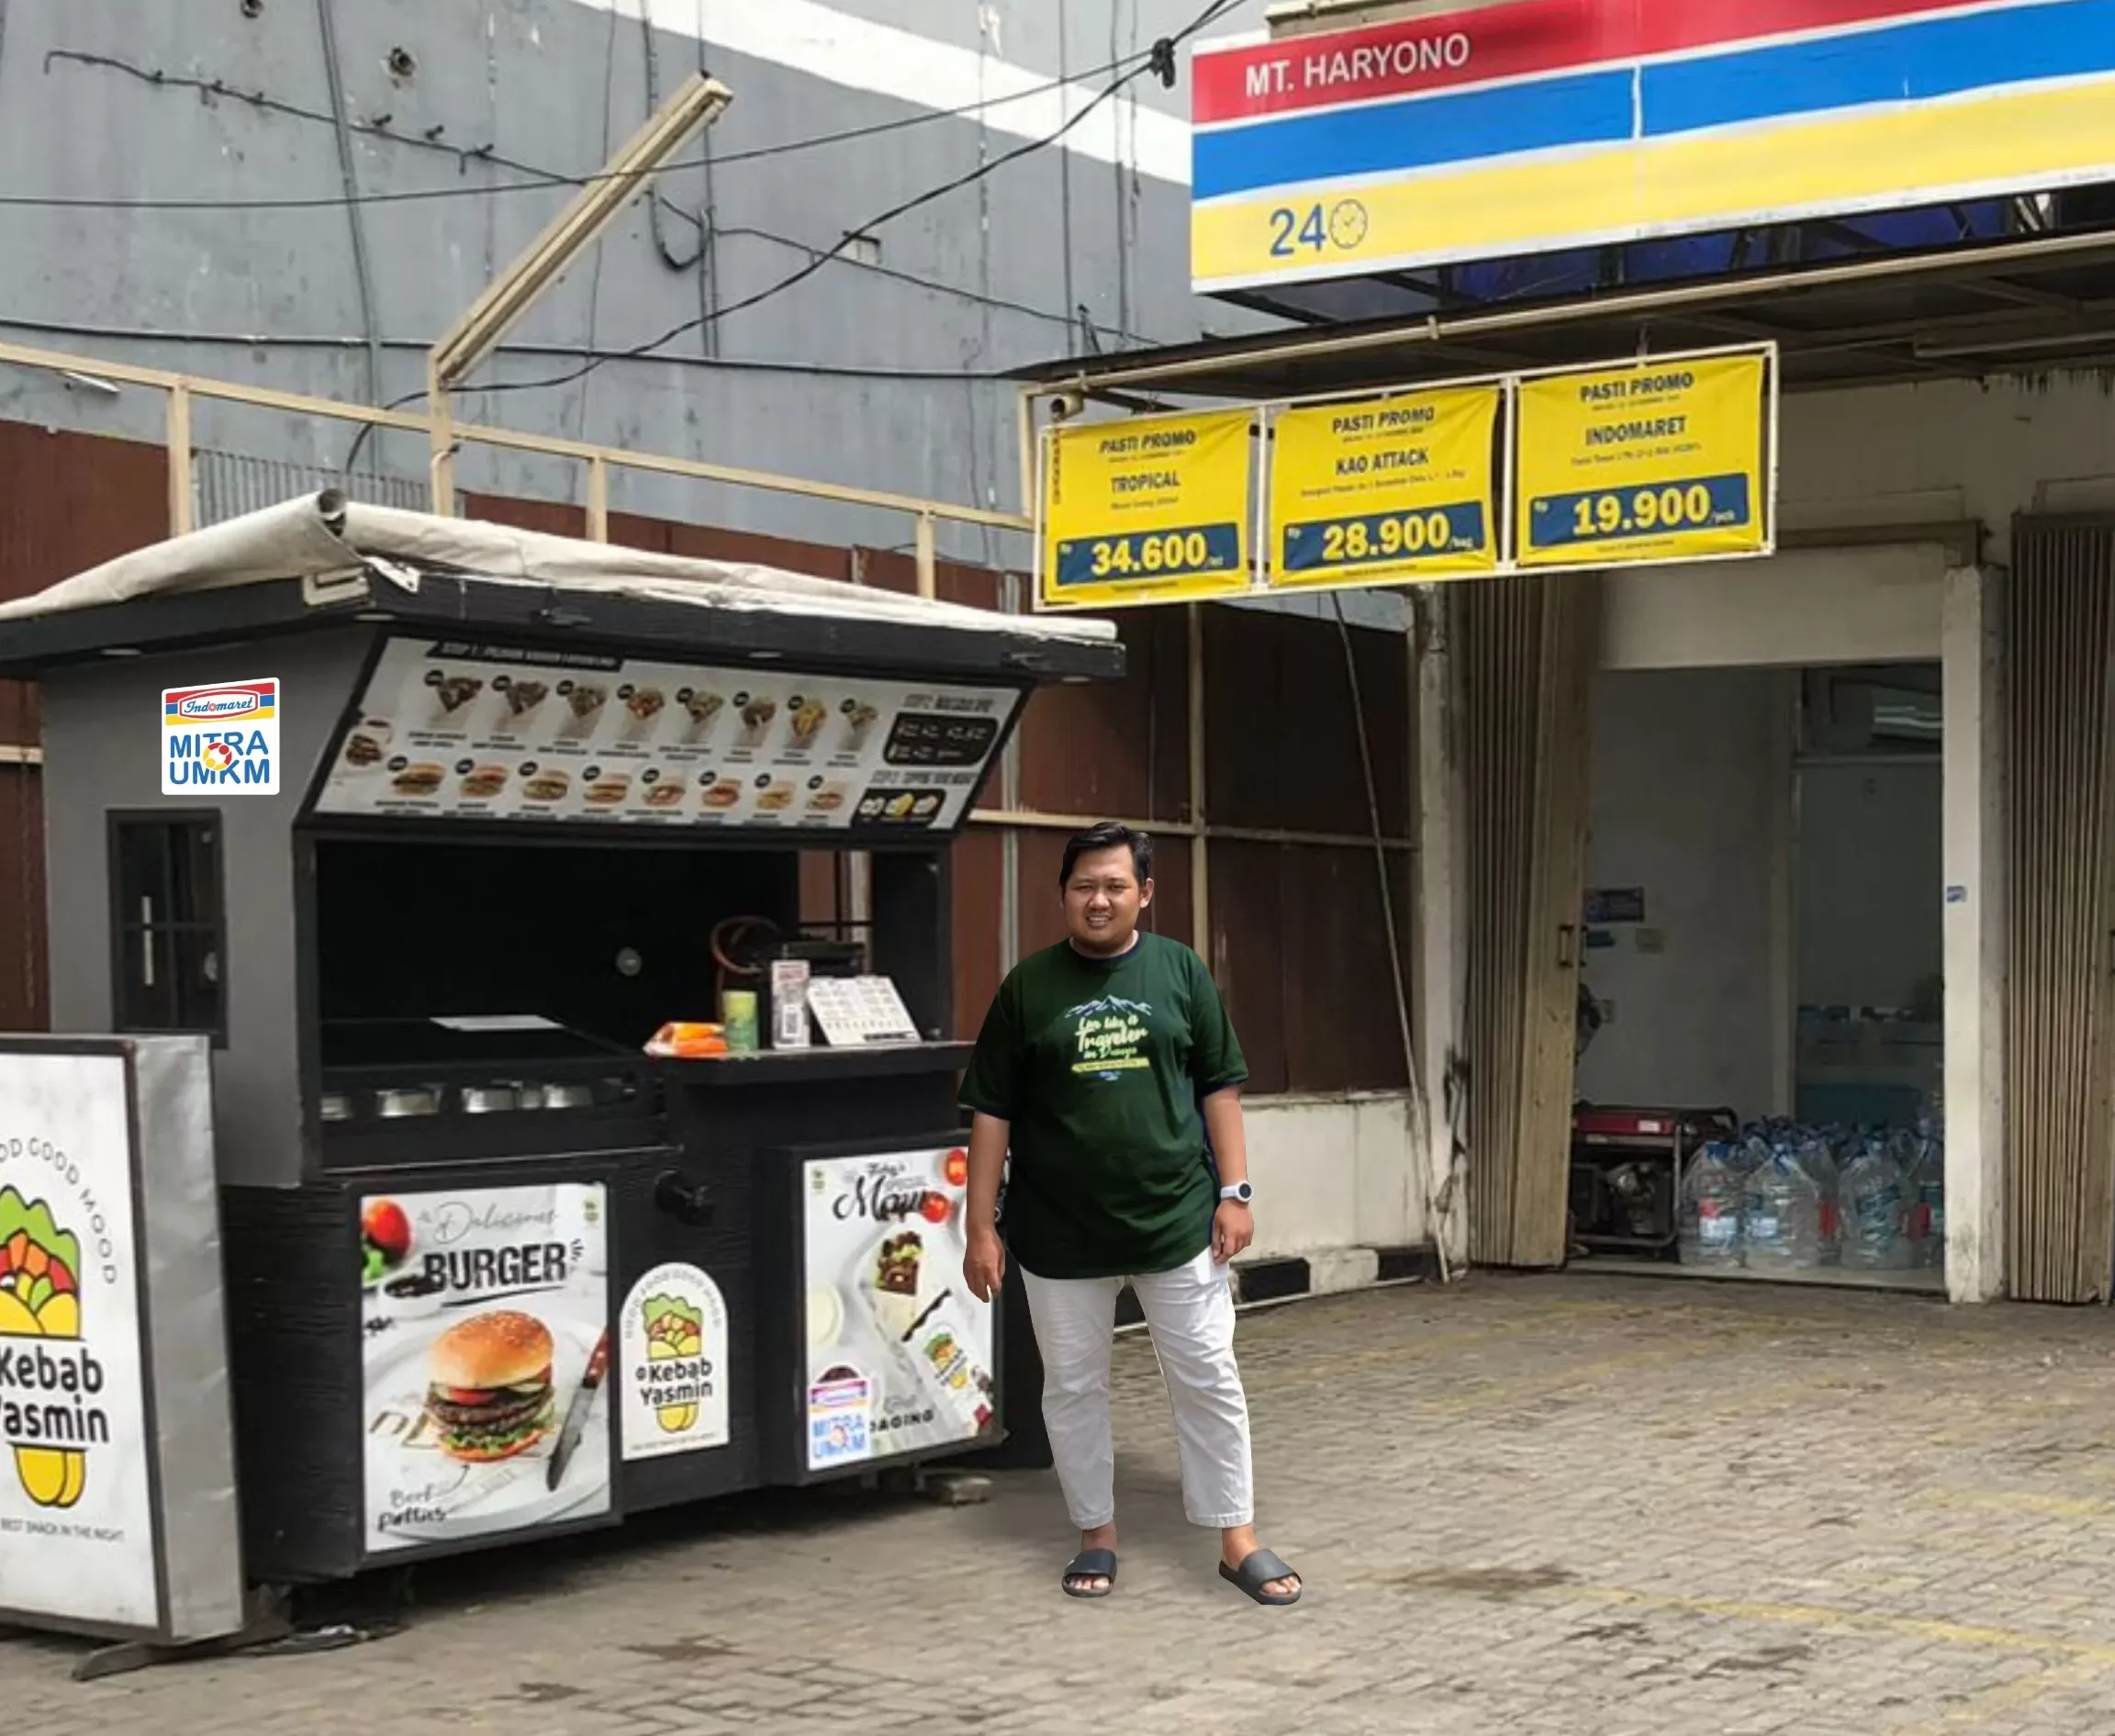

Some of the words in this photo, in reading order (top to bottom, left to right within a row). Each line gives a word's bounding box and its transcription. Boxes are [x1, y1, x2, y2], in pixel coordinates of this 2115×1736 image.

[1246, 60, 1294, 97] MT.
[1304, 33, 1470, 88] HARYONO
[1269, 204, 1326, 256] 24
[1580, 380, 1627, 402] PASTI
[1630, 372, 1695, 395] PROMO
[1333, 414, 1374, 434] PASTI
[1379, 407, 1435, 428] PROMO
[1585, 416, 1686, 446] INDOMARET
[1099, 436, 1139, 454] PASTI
[1141, 429, 1197, 449] PROMO
[1336, 456, 1368, 476] KAO
[1372, 447, 1429, 471] ATTACK
[1111, 470, 1181, 494] TROPICAL
[1572, 484, 1710, 535] 19.900
[1322, 511, 1449, 561] 28.900
[1091, 532, 1207, 577] 34.600
[184, 697, 253, 713] Indomaret
[170, 730, 269, 758] MITRA
[170, 759, 270, 785] UMKM
[423, 1243, 565, 1289] BURGER
[0, 1344, 104, 1394] Kebab
[640, 1379, 712, 1406] Yasmin
[0, 1394, 110, 1443] asmin
